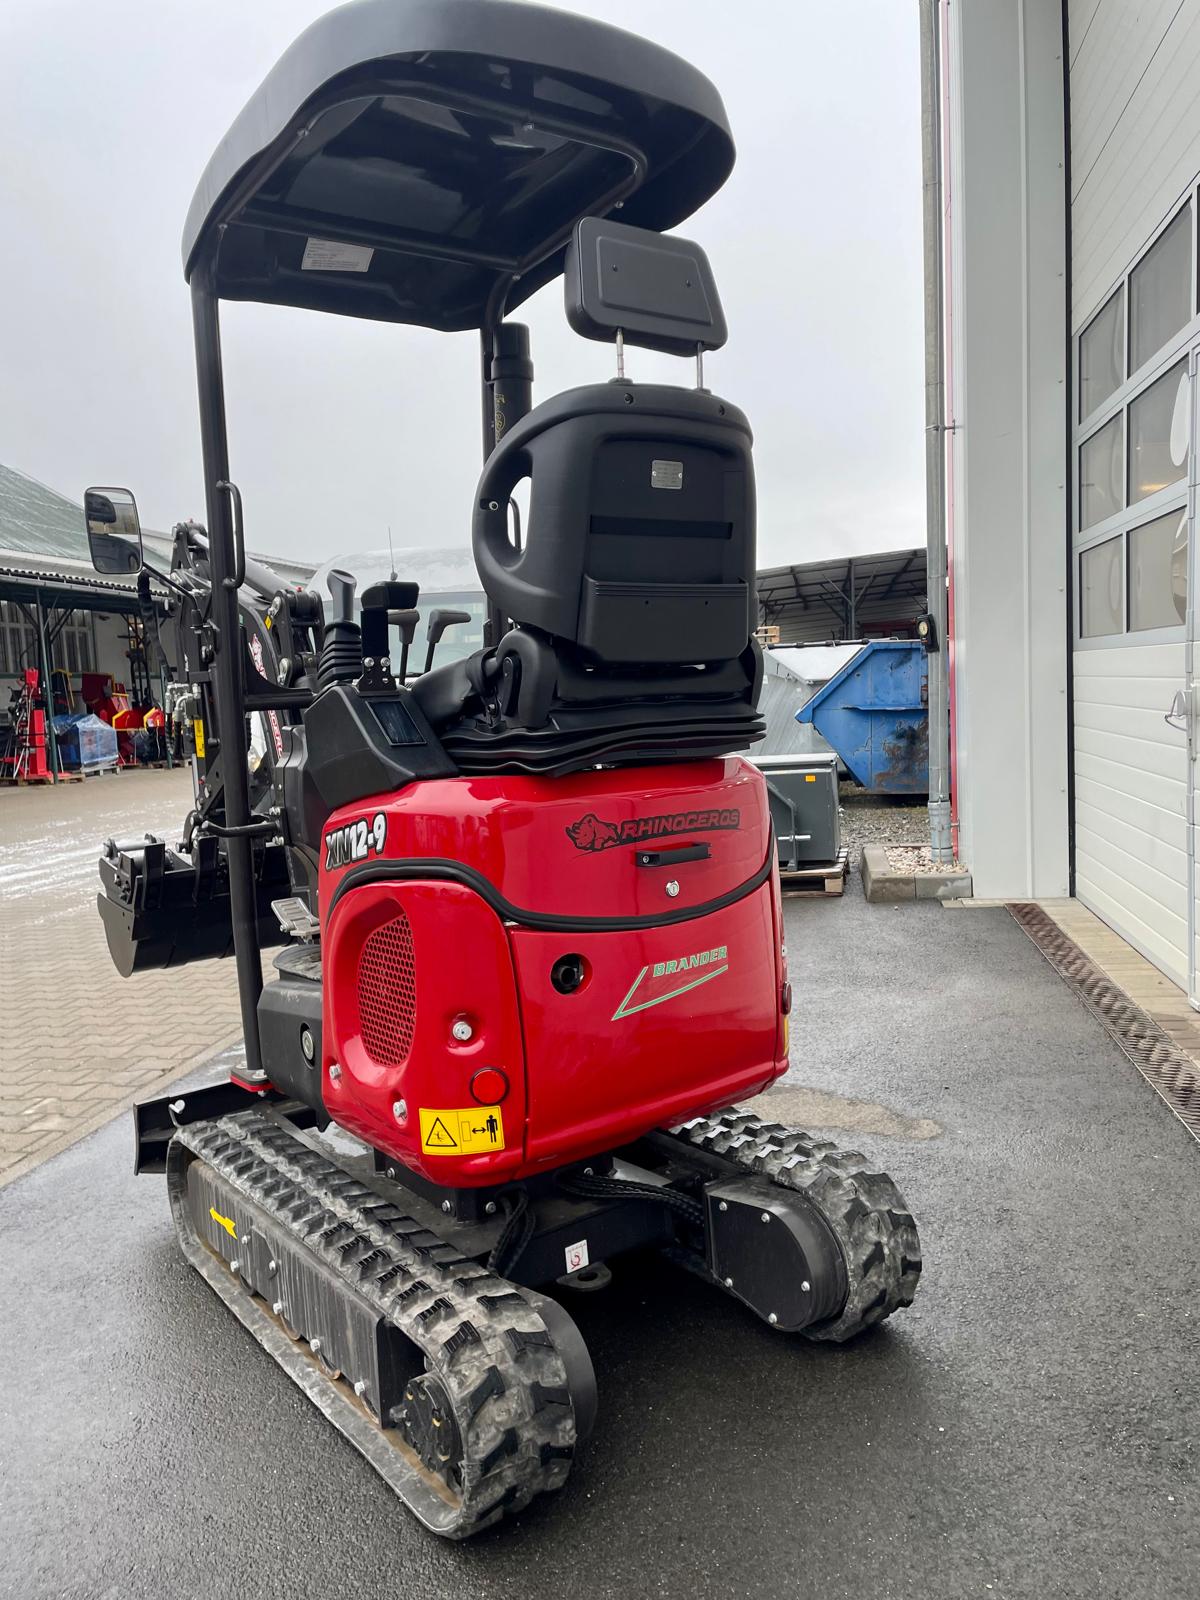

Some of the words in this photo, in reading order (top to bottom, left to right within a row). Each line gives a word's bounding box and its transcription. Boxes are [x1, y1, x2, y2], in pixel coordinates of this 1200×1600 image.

[622, 810, 739, 840] RHINOCEROS
[325, 812, 387, 871] XN12-9
[653, 945, 728, 977] BRANDER
